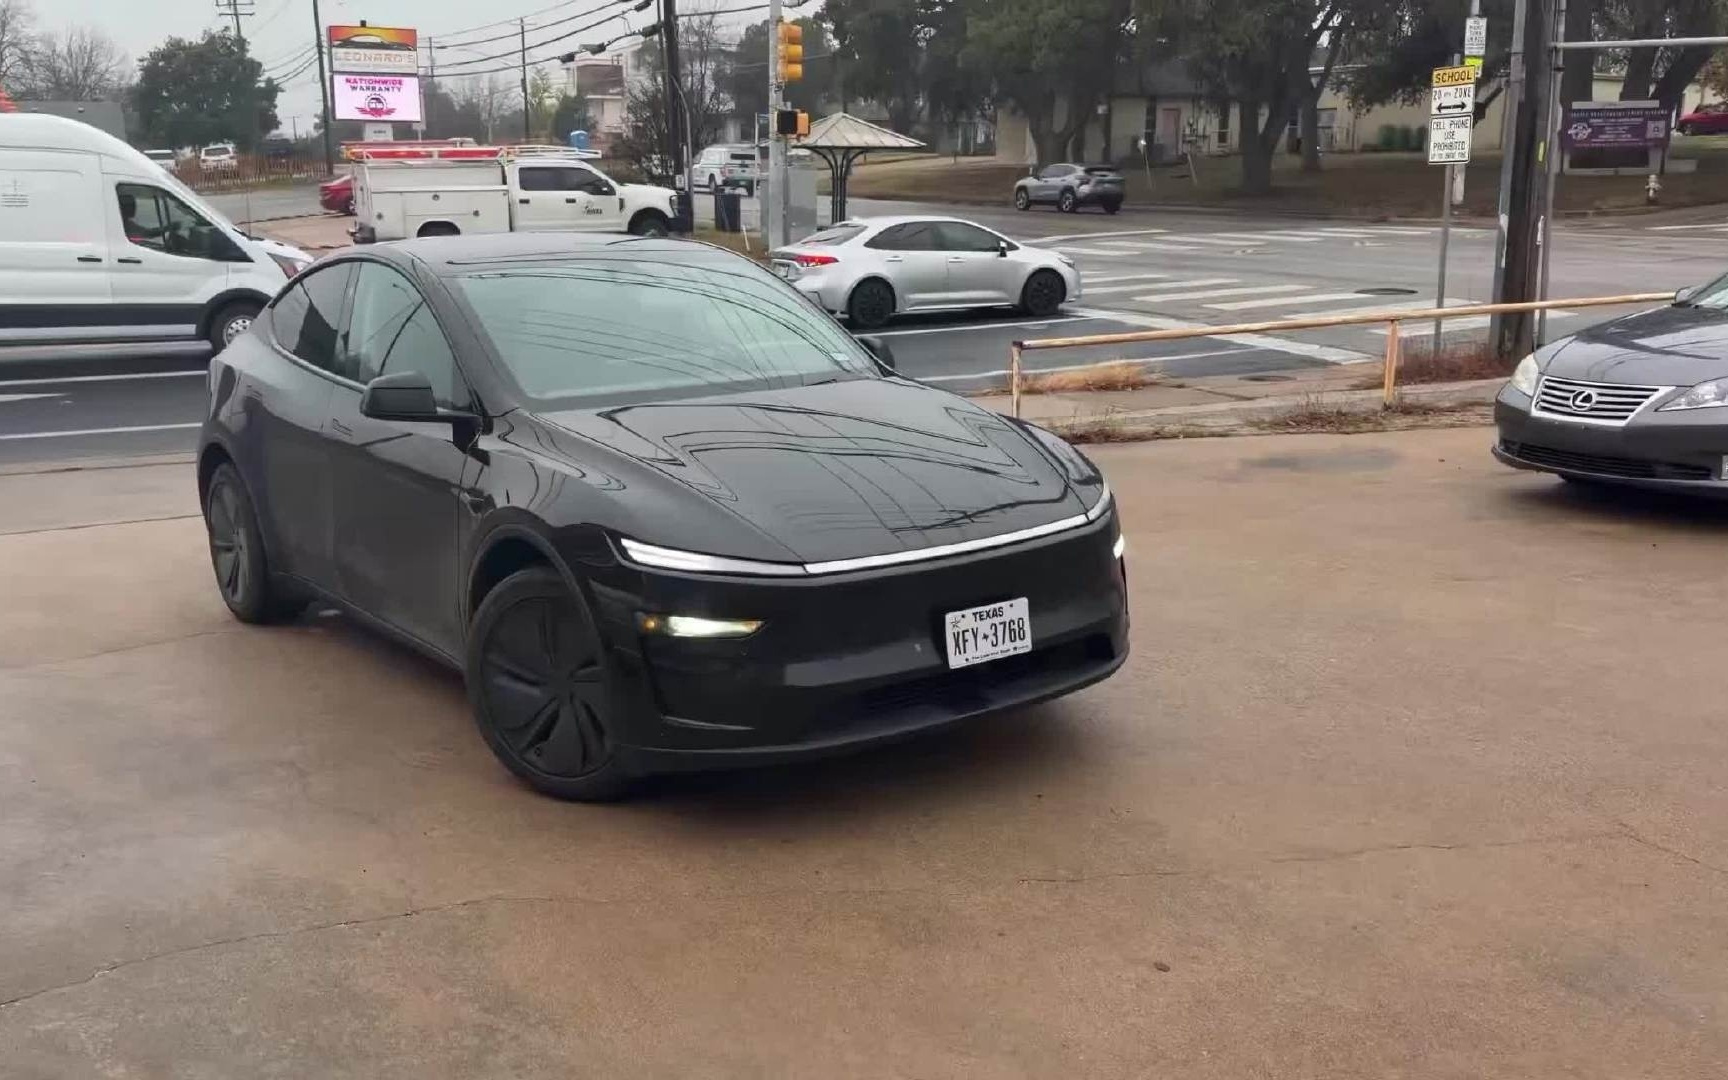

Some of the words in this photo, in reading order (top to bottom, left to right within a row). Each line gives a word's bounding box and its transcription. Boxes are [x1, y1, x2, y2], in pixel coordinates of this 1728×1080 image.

[345, 77, 404, 86] NATIONWIDE
[1434, 70, 1473, 84] SCHOOL
[350, 85, 402, 93] WARRANTY
[1433, 90, 1442, 100] 20
[1454, 87, 1472, 99] ZONE
[1432, 121, 1446, 130] CELL
[1449, 118, 1469, 129] PHONE
[1444, 130, 1456, 140] USE
[1433, 140, 1466, 151] PROHIBITED
[972, 606, 1004, 623] TEXAS
